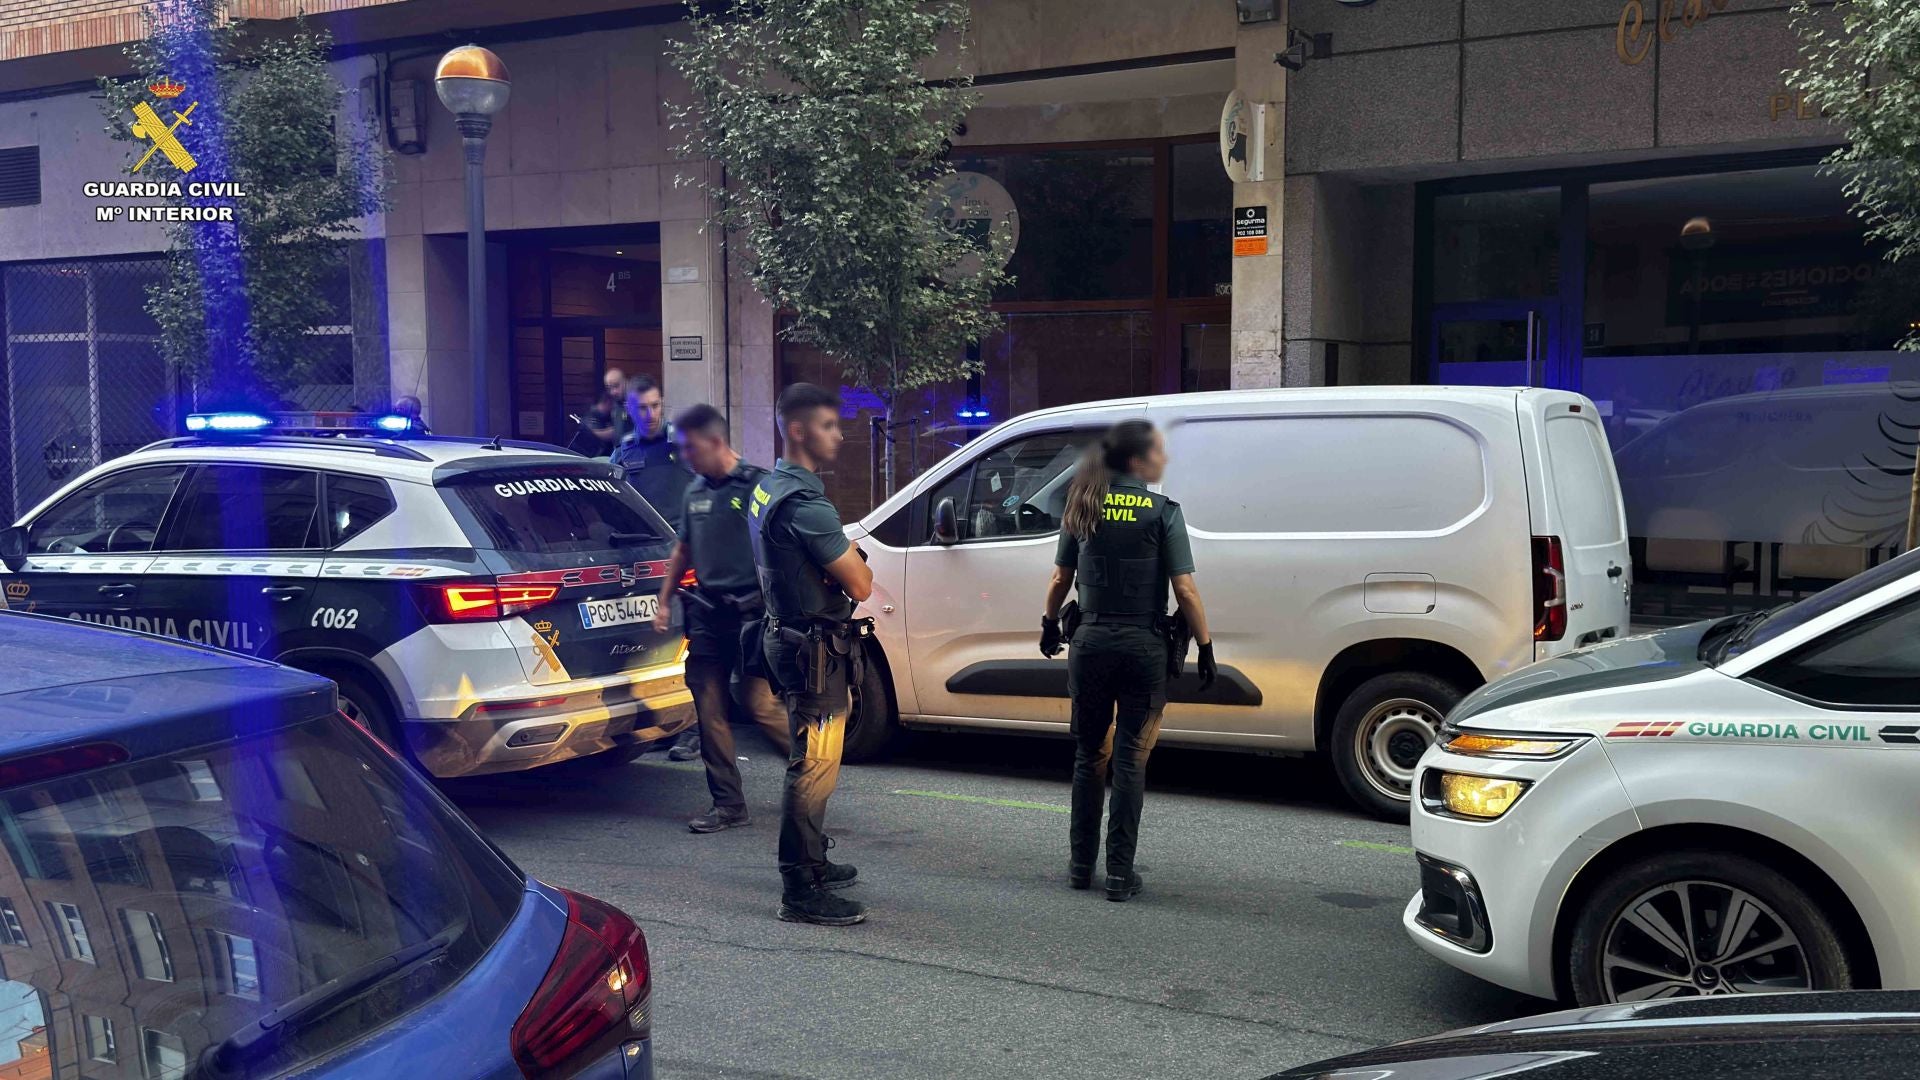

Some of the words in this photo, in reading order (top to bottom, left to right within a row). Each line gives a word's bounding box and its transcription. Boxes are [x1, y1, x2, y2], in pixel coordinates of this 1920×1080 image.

[1236, 218, 1265, 226] segurma
[606, 272, 616, 292] 4
[618, 271, 631, 280] BIS
[494, 478, 582, 498] GUARDIA
[579, 478, 621, 494] CIVIL
[1103, 493, 1153, 508] ARDIA
[588, 603, 616, 624] PGC
[616, 600, 651, 620] 5442
[188, 618, 254, 650] CIVIL
[609, 643, 648, 656] Ateca
[1688, 722, 1800, 740] GUARDIA
[1808, 724, 1871, 742] CIVIL
